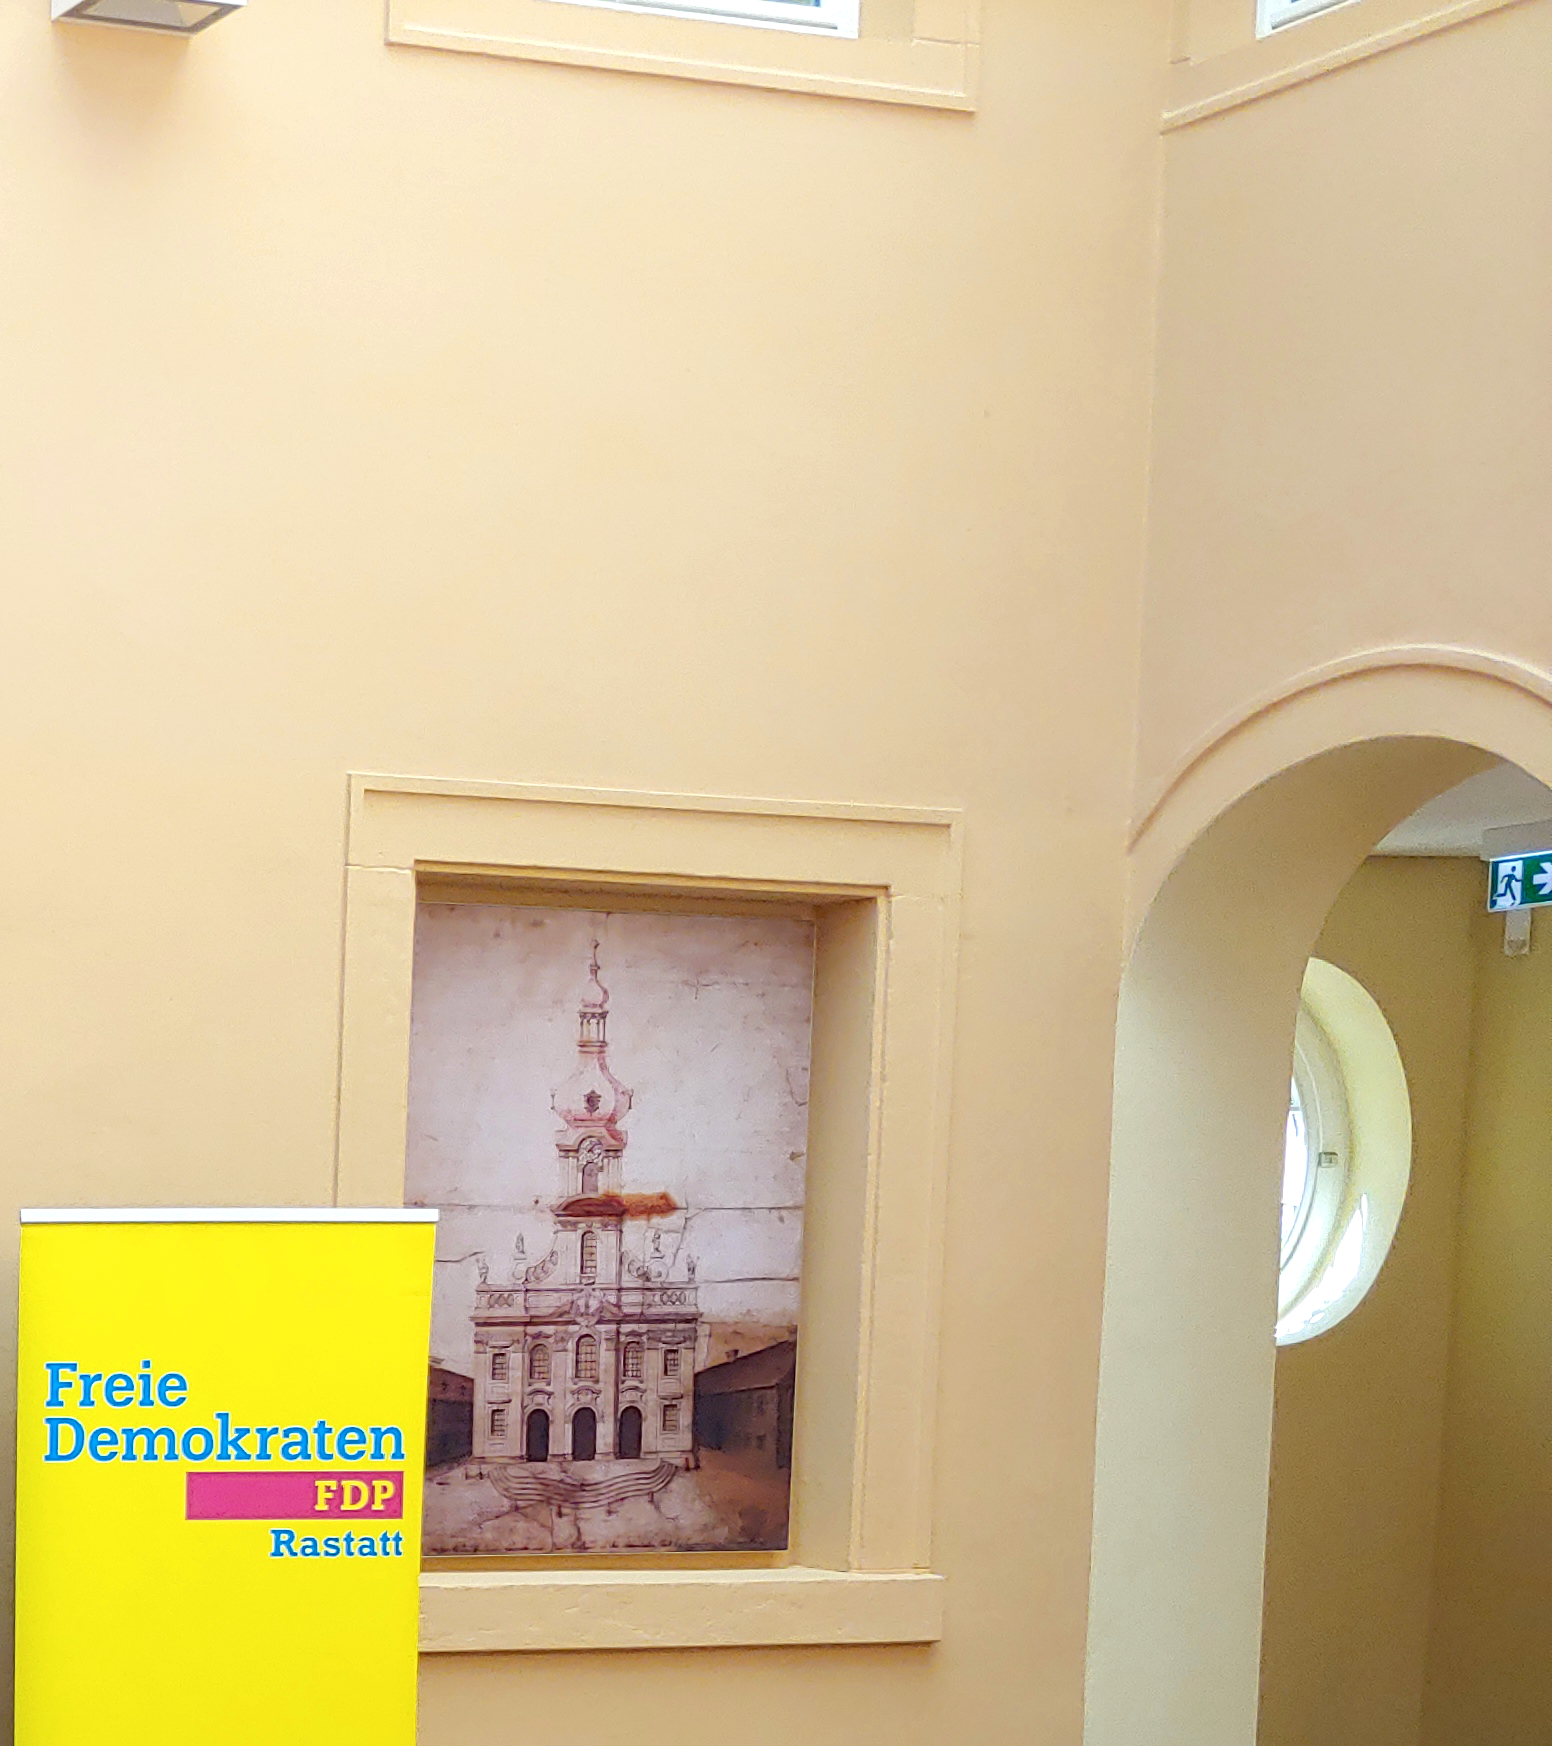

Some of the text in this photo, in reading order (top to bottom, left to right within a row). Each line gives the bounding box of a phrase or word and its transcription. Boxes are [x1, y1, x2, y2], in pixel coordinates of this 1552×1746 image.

[45, 1359, 188, 1408] Freie
[43, 1412, 406, 1462] Demokraten
[313, 1479, 395, 1512] FDP
[269, 1528, 404, 1558] Rastatt
